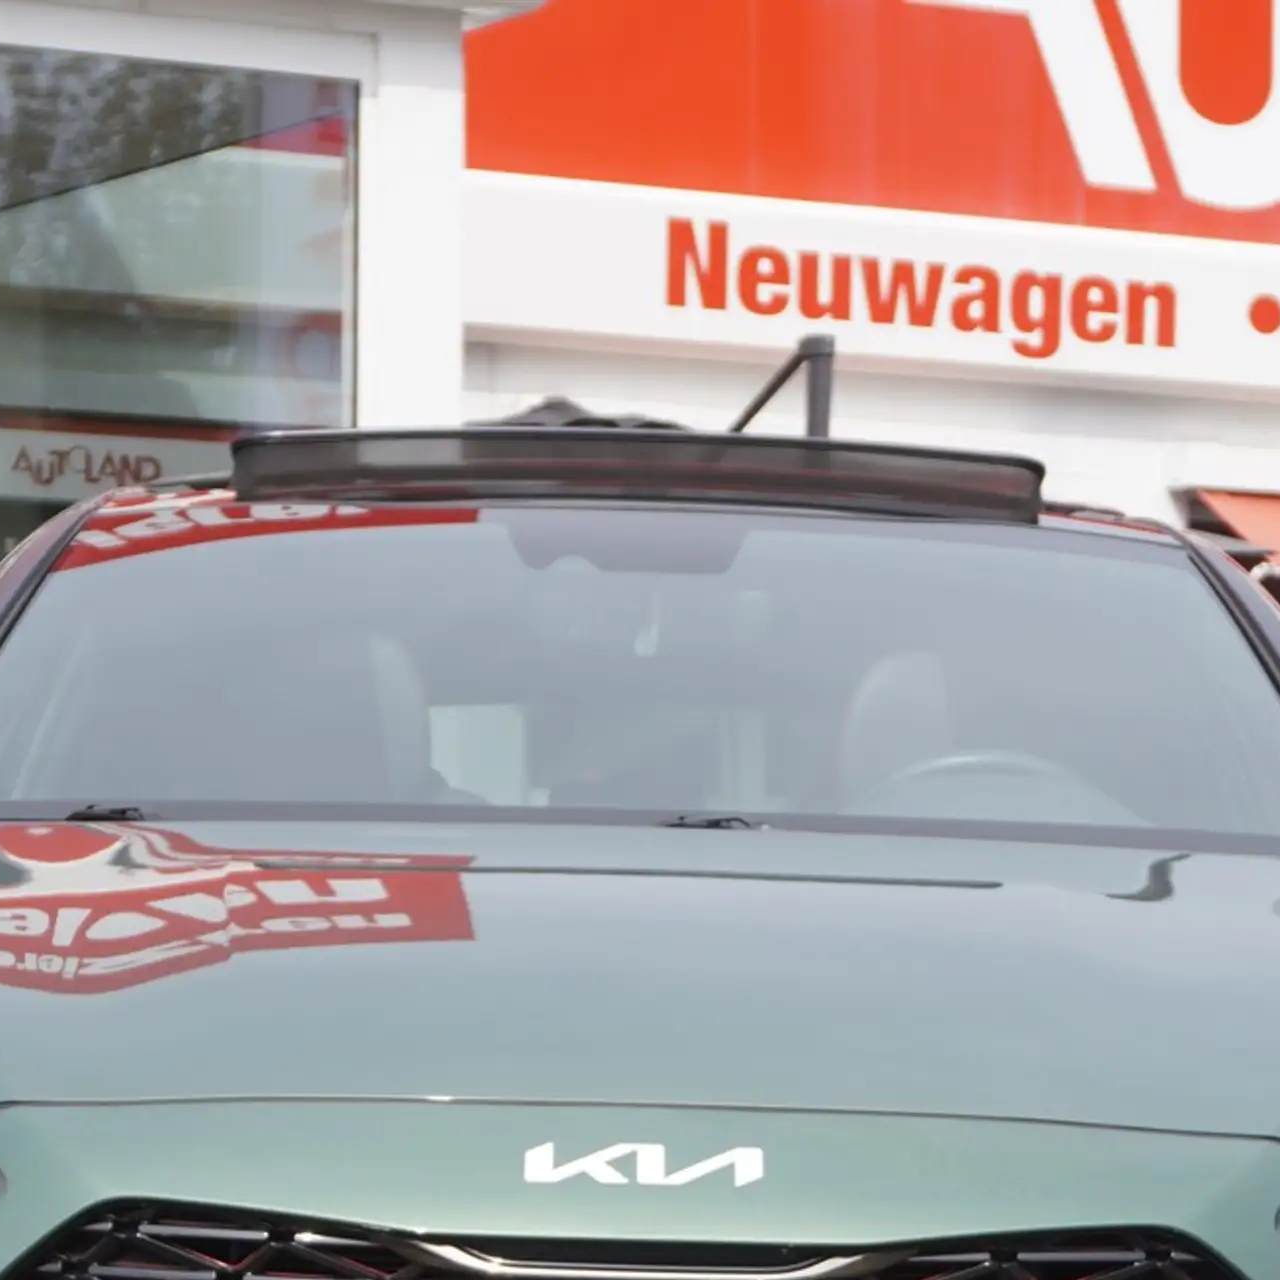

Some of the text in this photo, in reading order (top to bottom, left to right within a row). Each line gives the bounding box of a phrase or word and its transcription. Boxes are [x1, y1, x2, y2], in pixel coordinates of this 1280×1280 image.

[666, 218, 1177, 359] Neuwagen
[11, 445, 163, 488] AUTOLAND
[524, 1141, 764, 1188] KIA
